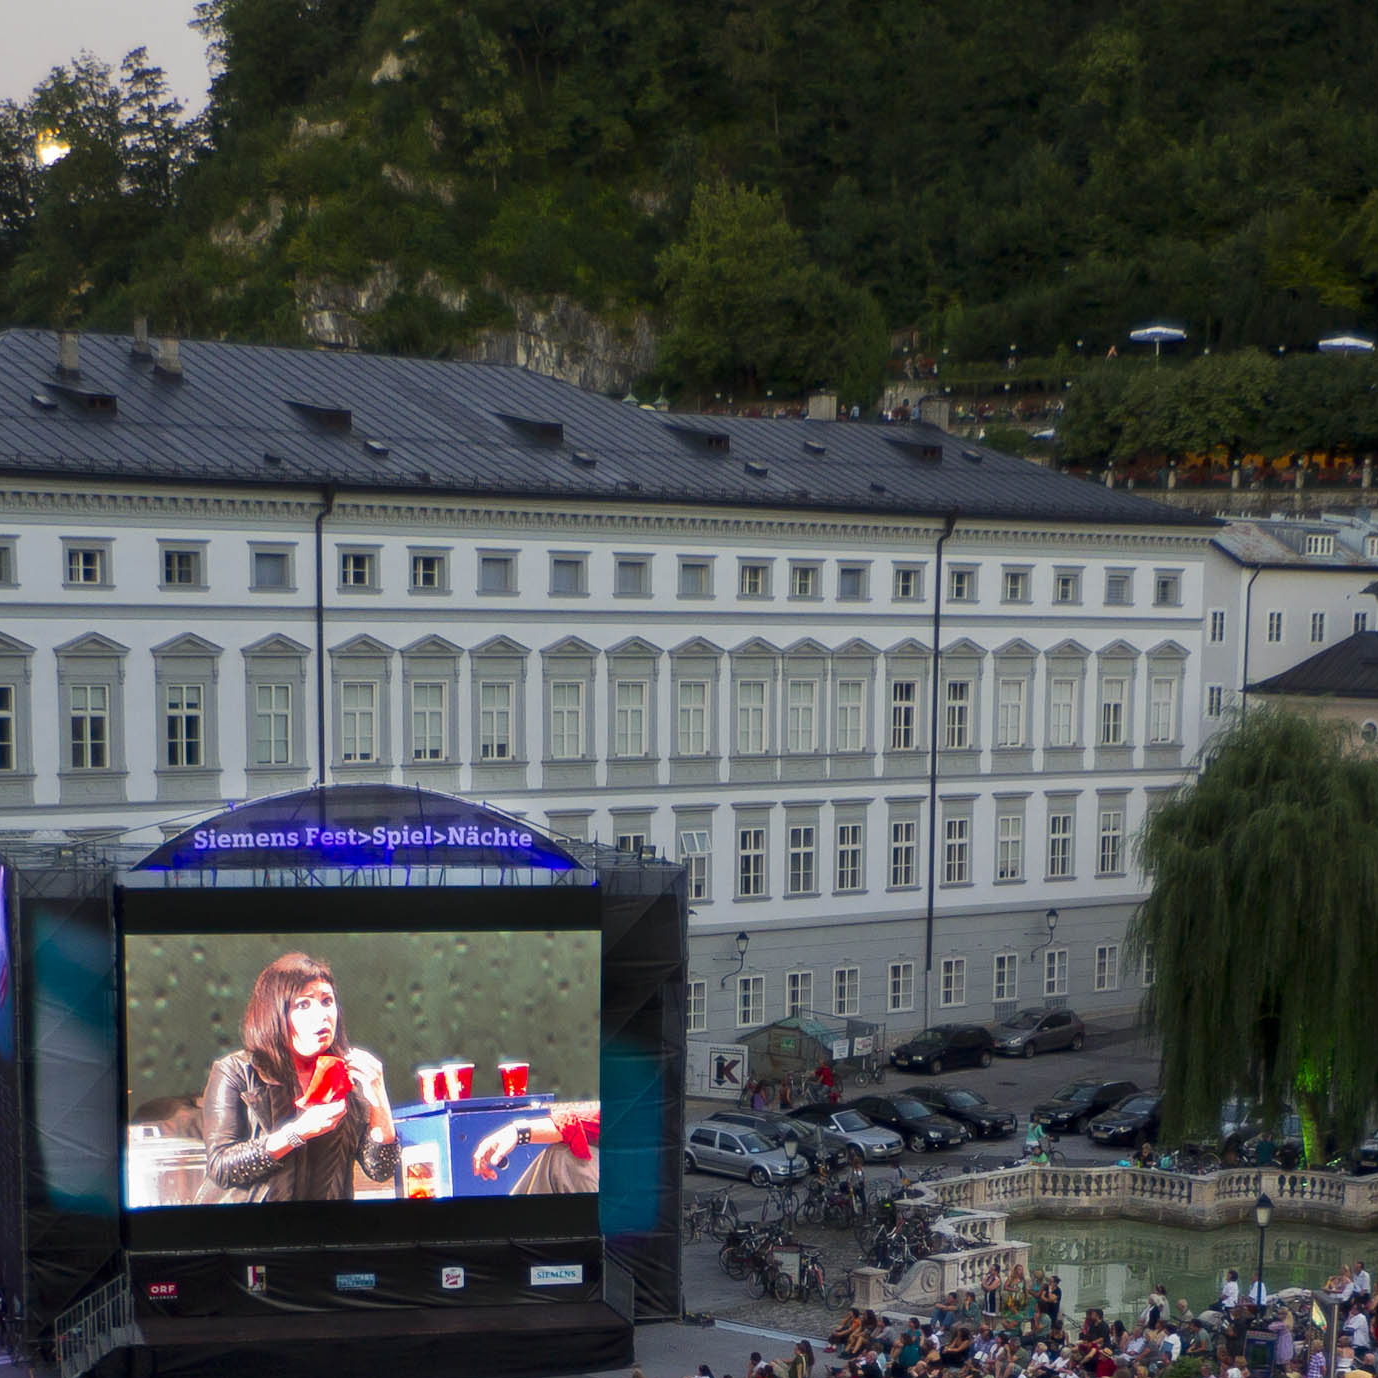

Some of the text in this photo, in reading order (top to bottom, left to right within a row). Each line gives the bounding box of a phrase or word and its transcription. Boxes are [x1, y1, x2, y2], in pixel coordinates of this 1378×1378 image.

[194, 829, 299, 849] Siemens
[536, 1270, 576, 1280] SIEMENS
[150, 1285, 175, 1294] ORF
